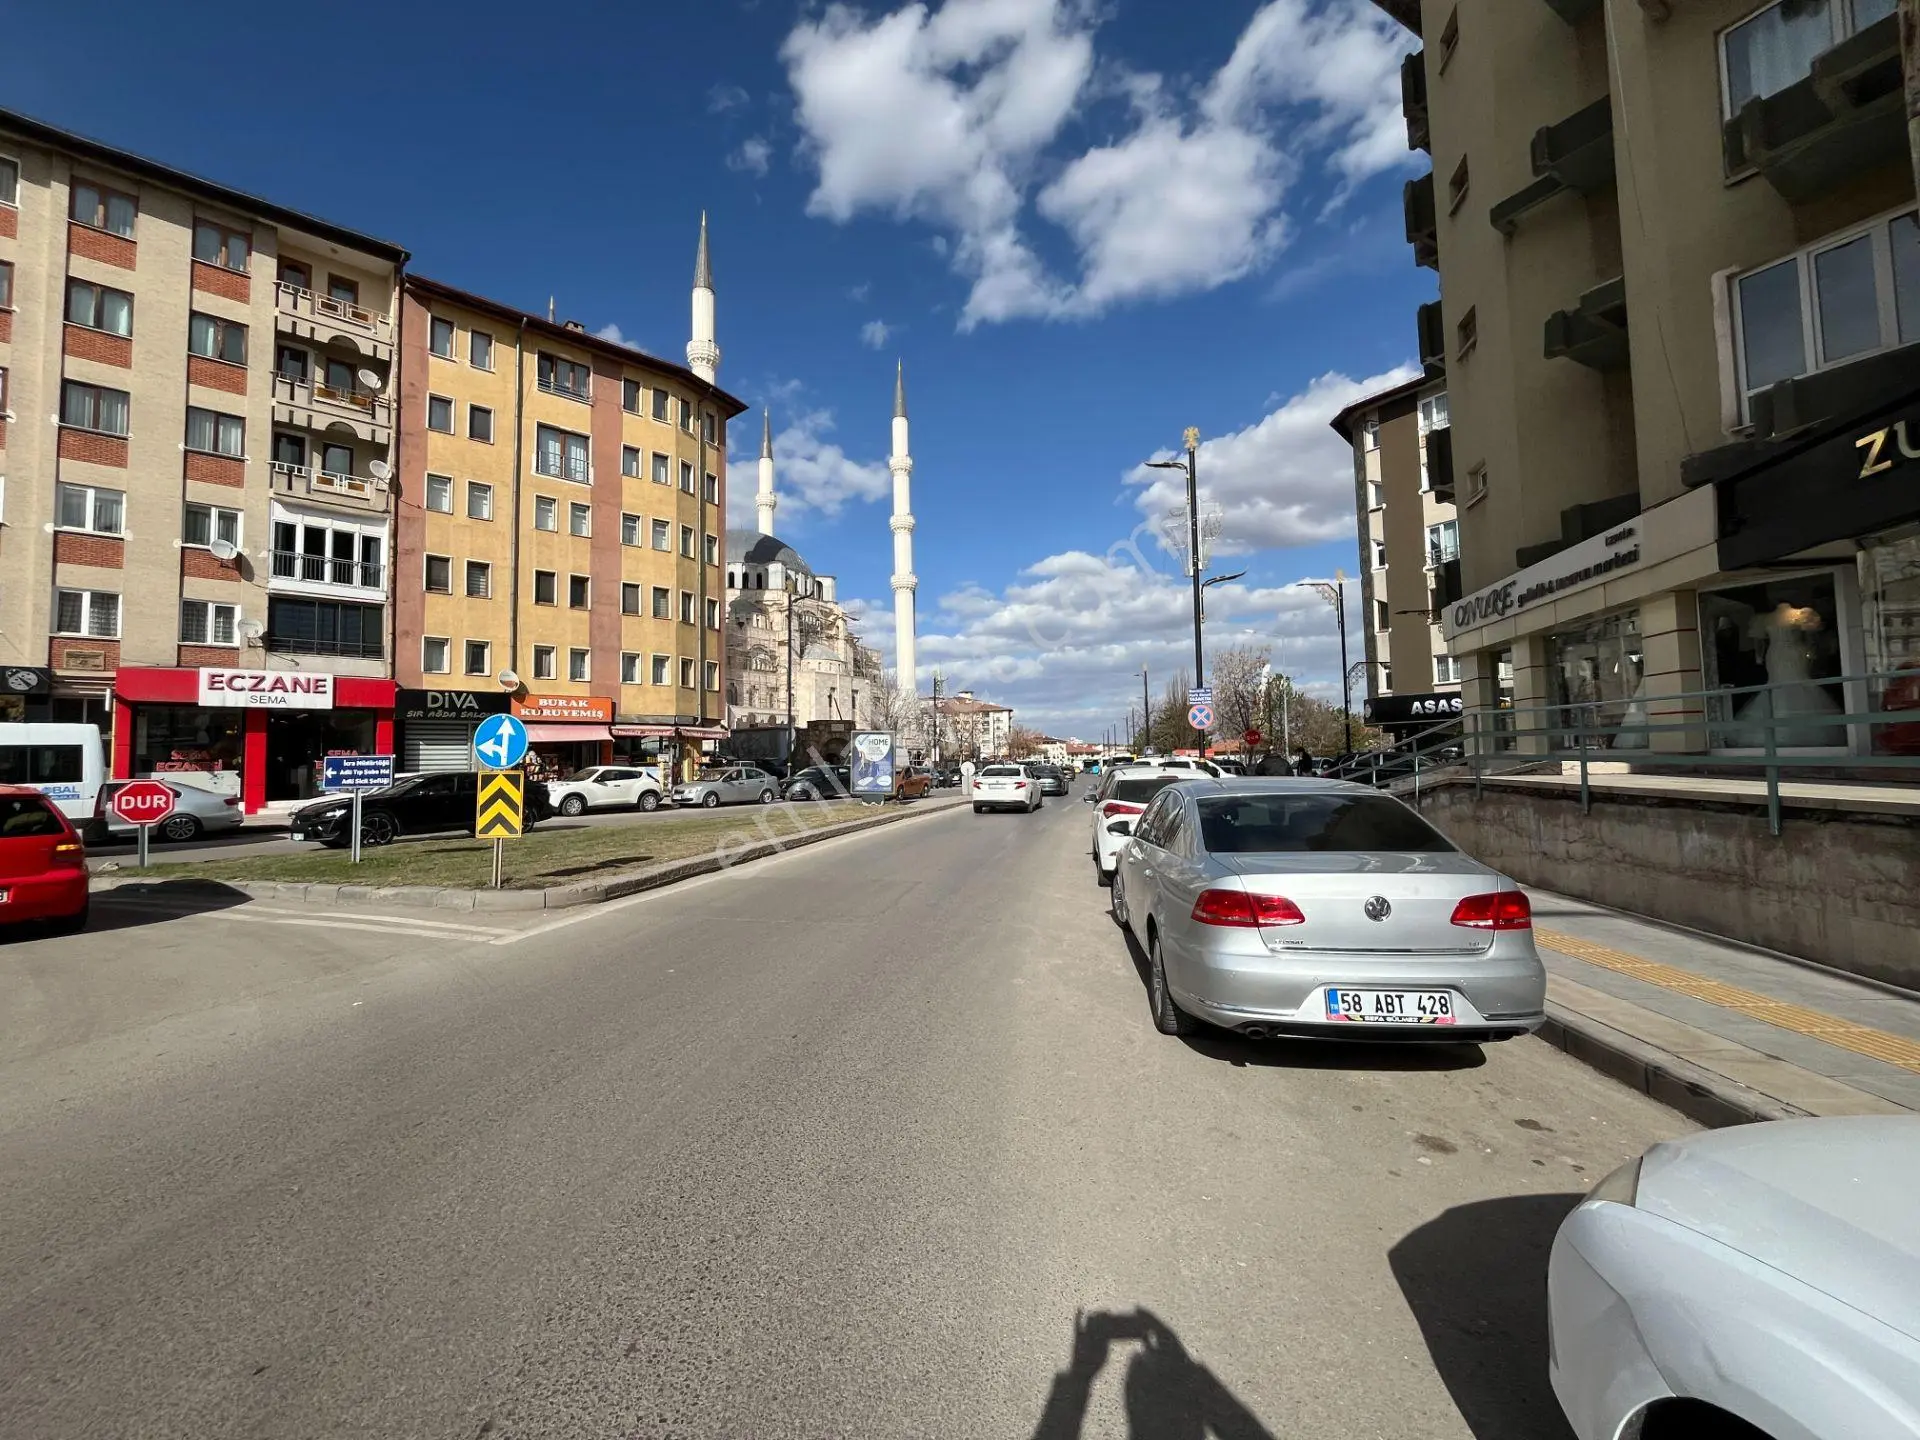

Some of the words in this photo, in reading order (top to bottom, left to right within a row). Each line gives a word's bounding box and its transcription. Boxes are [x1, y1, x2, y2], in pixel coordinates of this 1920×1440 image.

[207, 673, 328, 695] ECZANE
[250, 695, 288, 705] SEMA
[538, 698, 588, 708] BURAK
[406, 710, 424, 718] SIR
[520, 708, 604, 720] KURUYEMİŞ
[121, 795, 167, 810] DUR
[1340, 993, 1362, 1013] 58
[1375, 994, 1405, 1014] ABT
[1417, 995, 1450, 1015] 428
